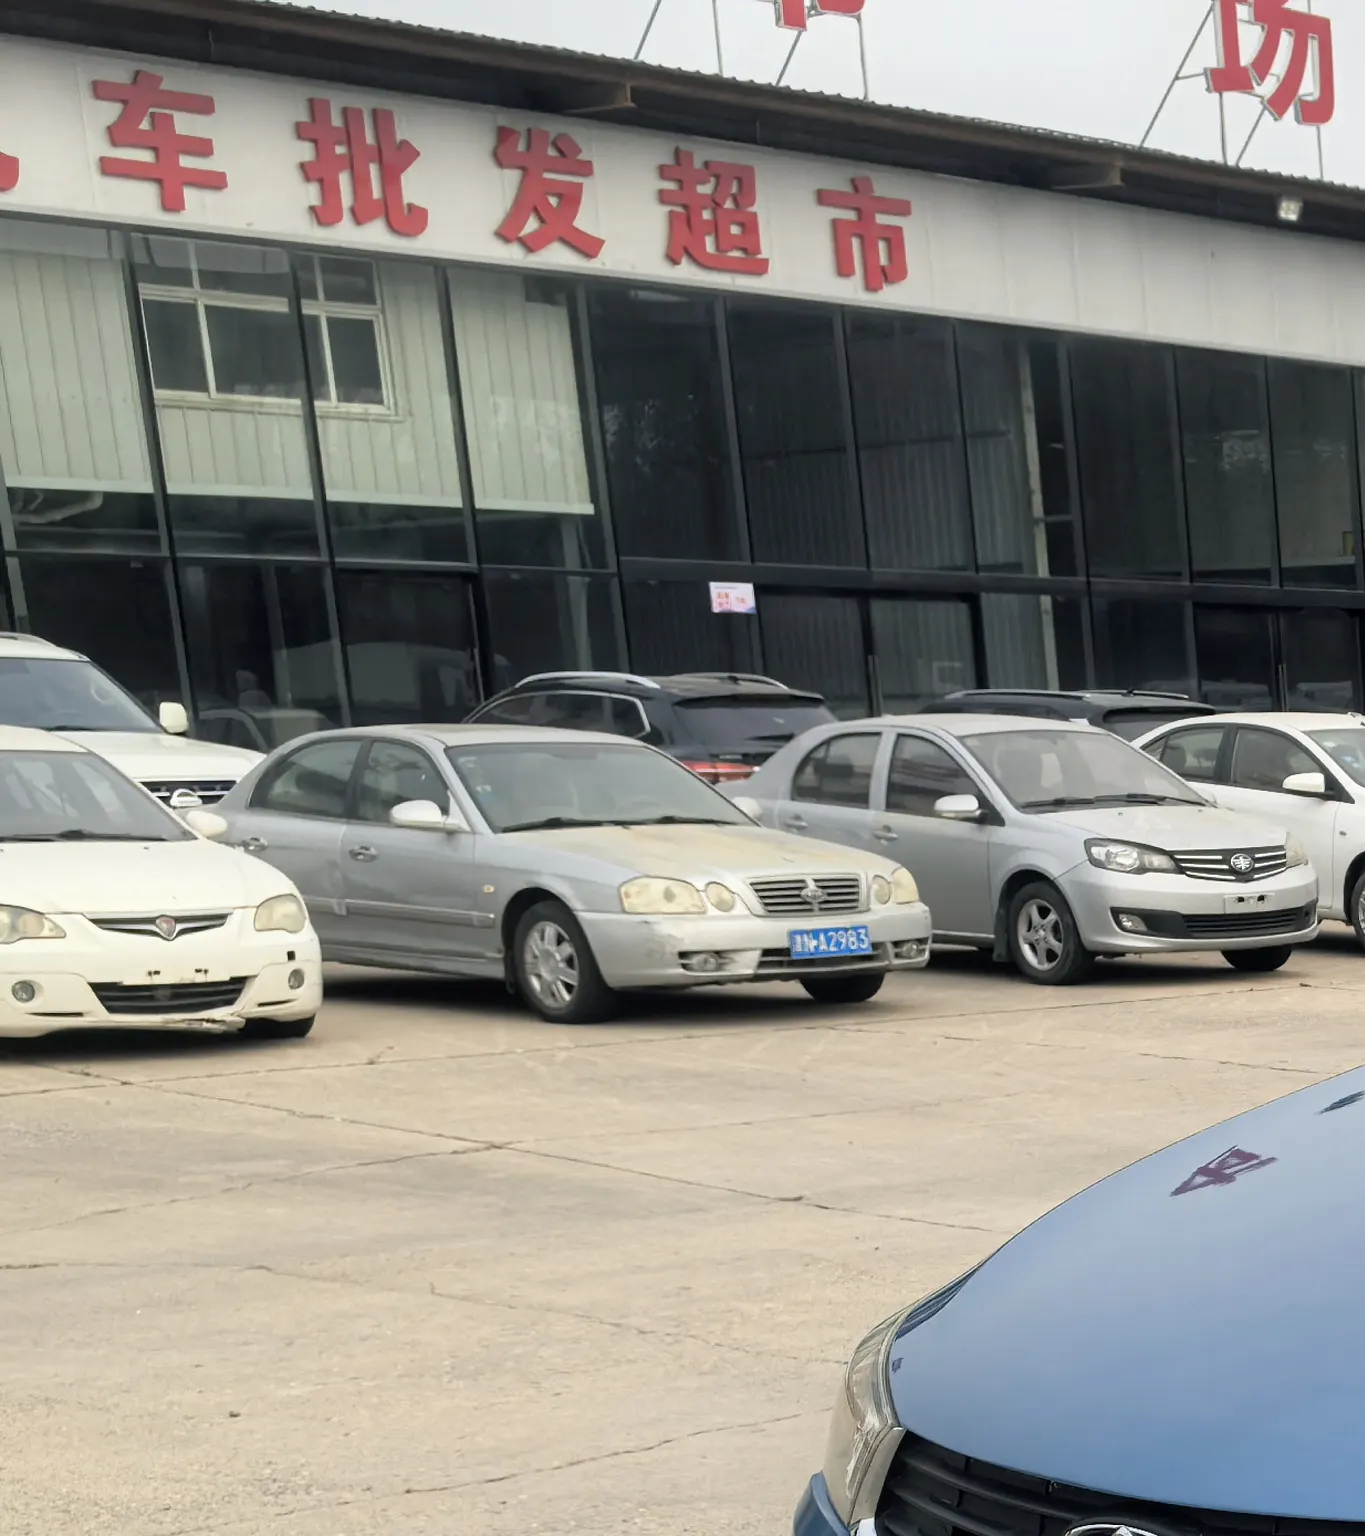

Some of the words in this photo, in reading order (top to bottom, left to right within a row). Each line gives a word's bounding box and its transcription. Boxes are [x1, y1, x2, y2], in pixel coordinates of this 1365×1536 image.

[0, 70, 913, 292] 车批发超市
